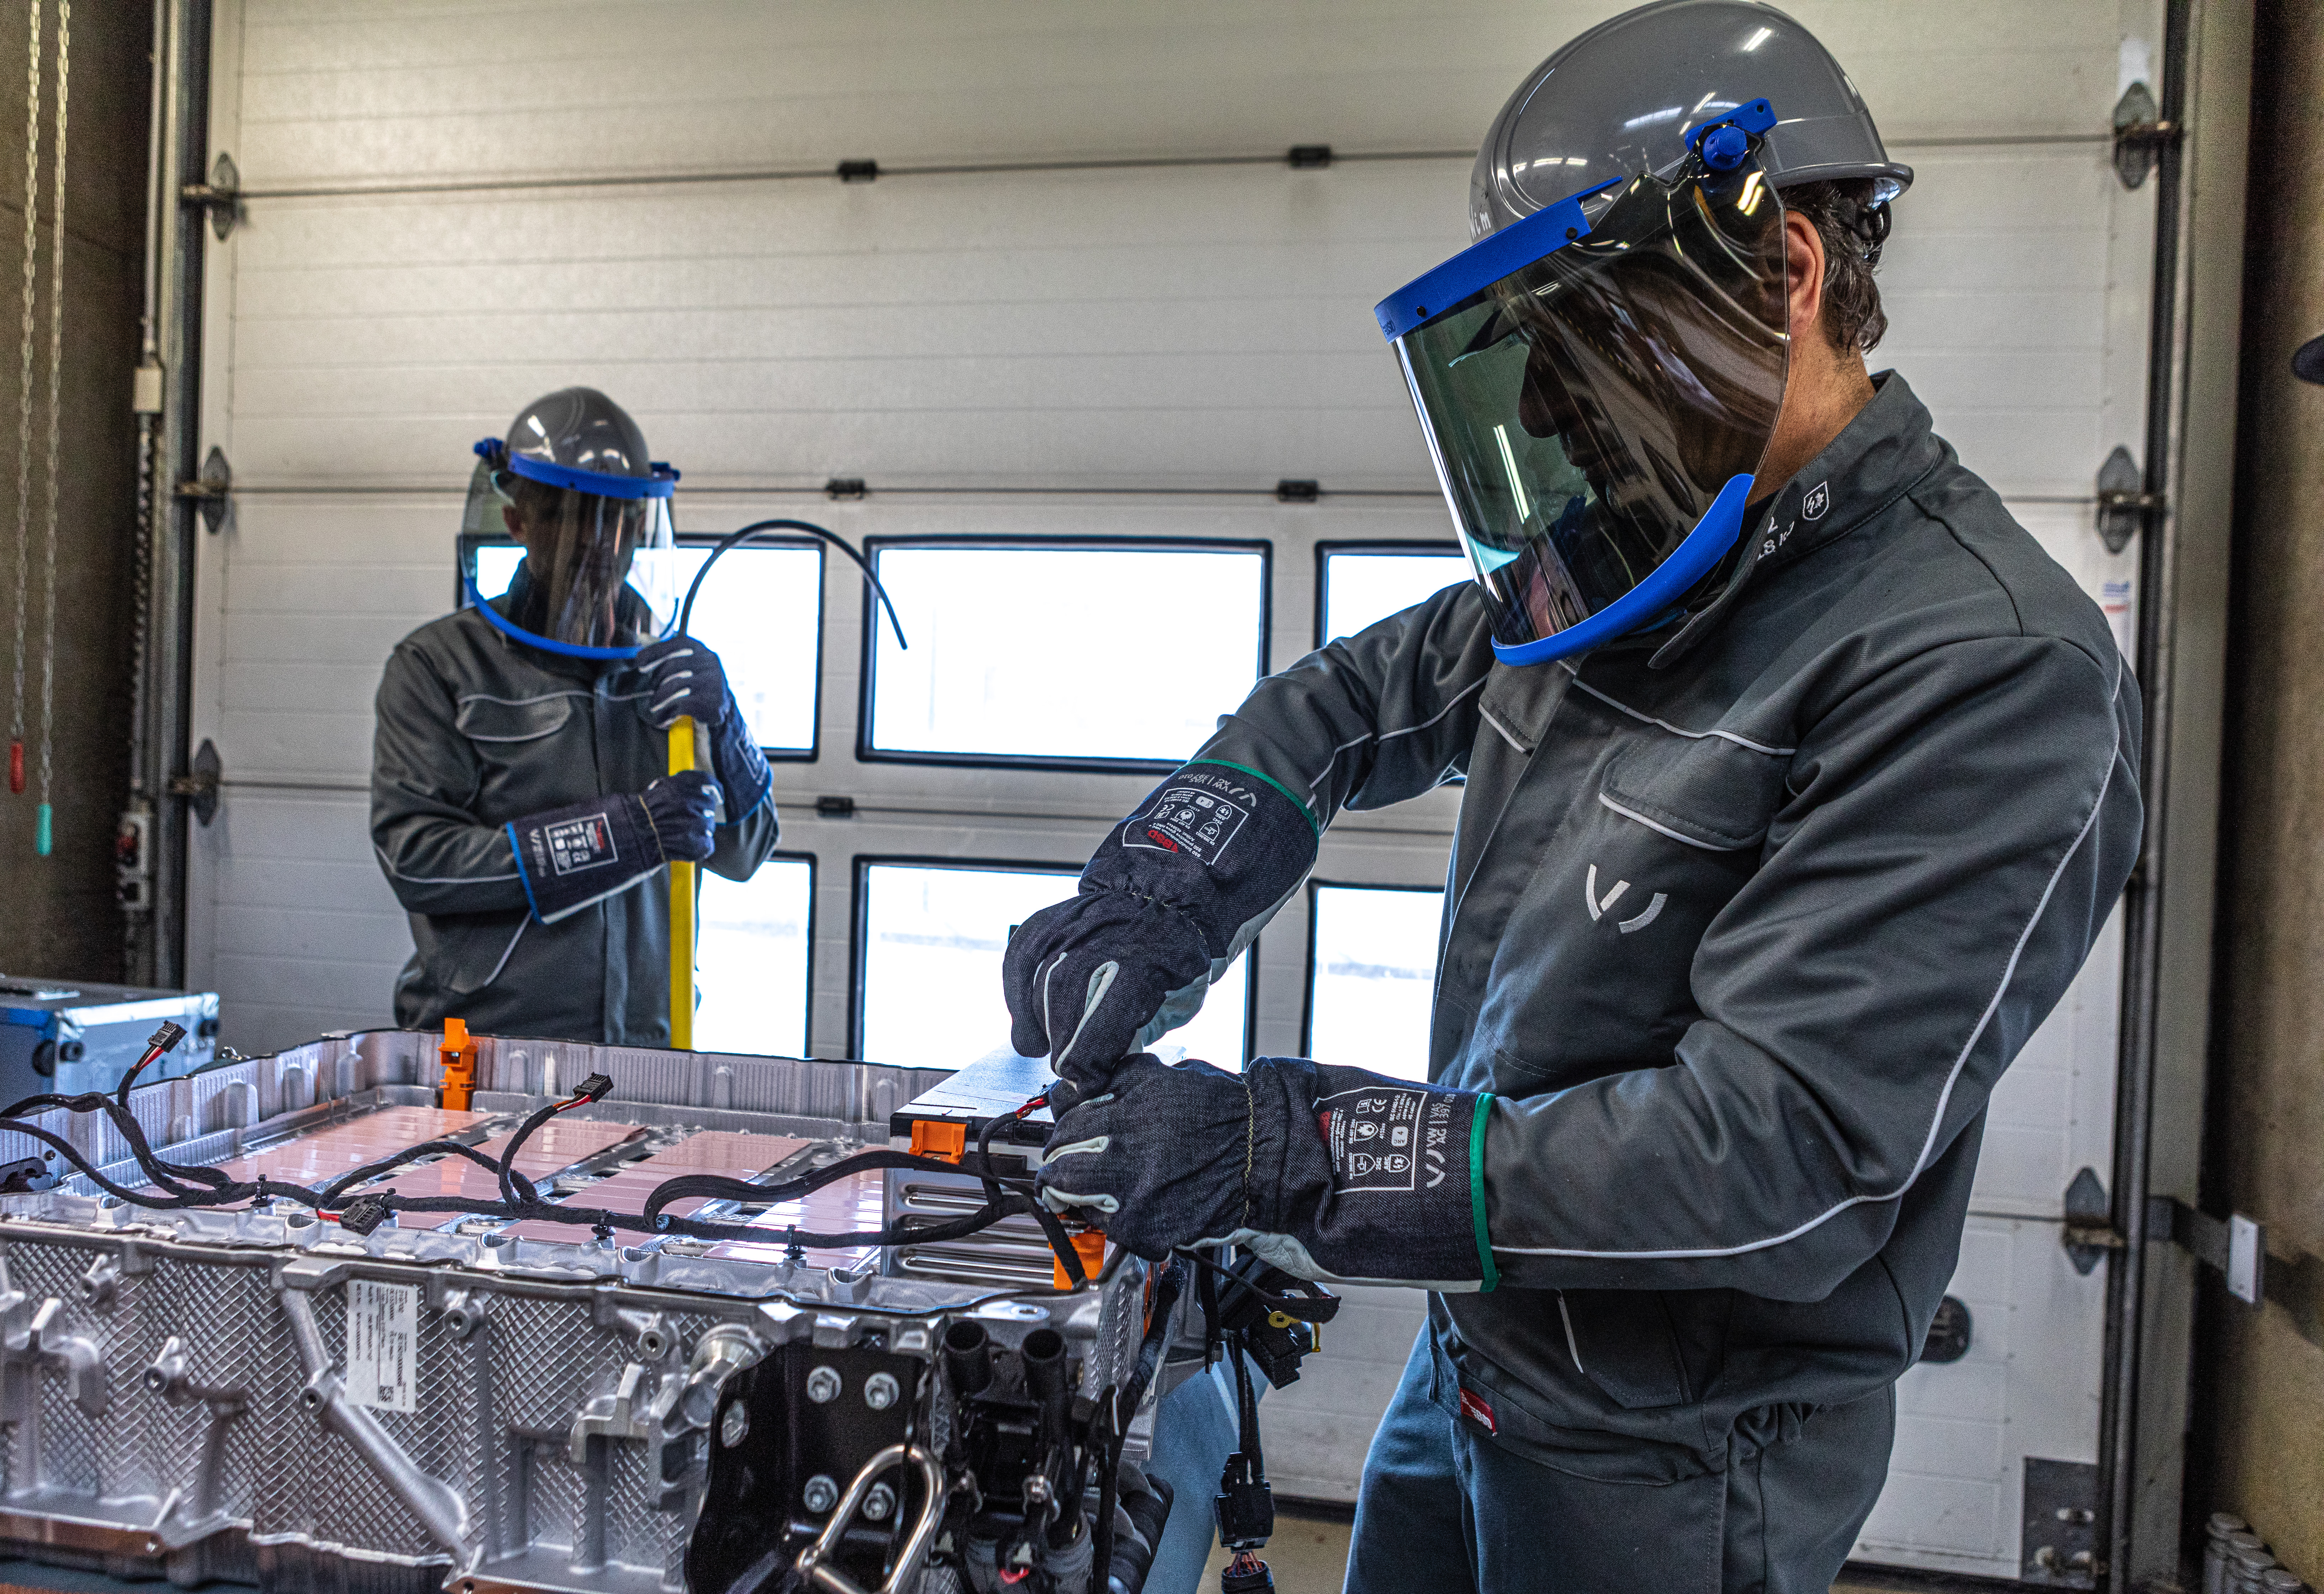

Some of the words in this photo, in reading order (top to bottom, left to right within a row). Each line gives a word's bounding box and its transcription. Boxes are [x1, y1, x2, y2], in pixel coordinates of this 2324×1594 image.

[1212, 782, 1227, 791] VW
[1212, 817, 1223, 825] 2542
[1164, 825, 1176, 834] glove
[1181, 831, 1195, 841] Artikel:
[1147, 830, 1173, 849] BSD
[1161, 828, 1192, 852] Schutzhandschuh
[1175, 832, 1194, 846] protective
[1372, 1098, 1387, 1113] CE
[1430, 1103, 1441, 1117] VAS
[1440, 1104, 1451, 1119] 397
[1426, 1128, 1436, 1146] VW
[1437, 1128, 1447, 1143] AG
